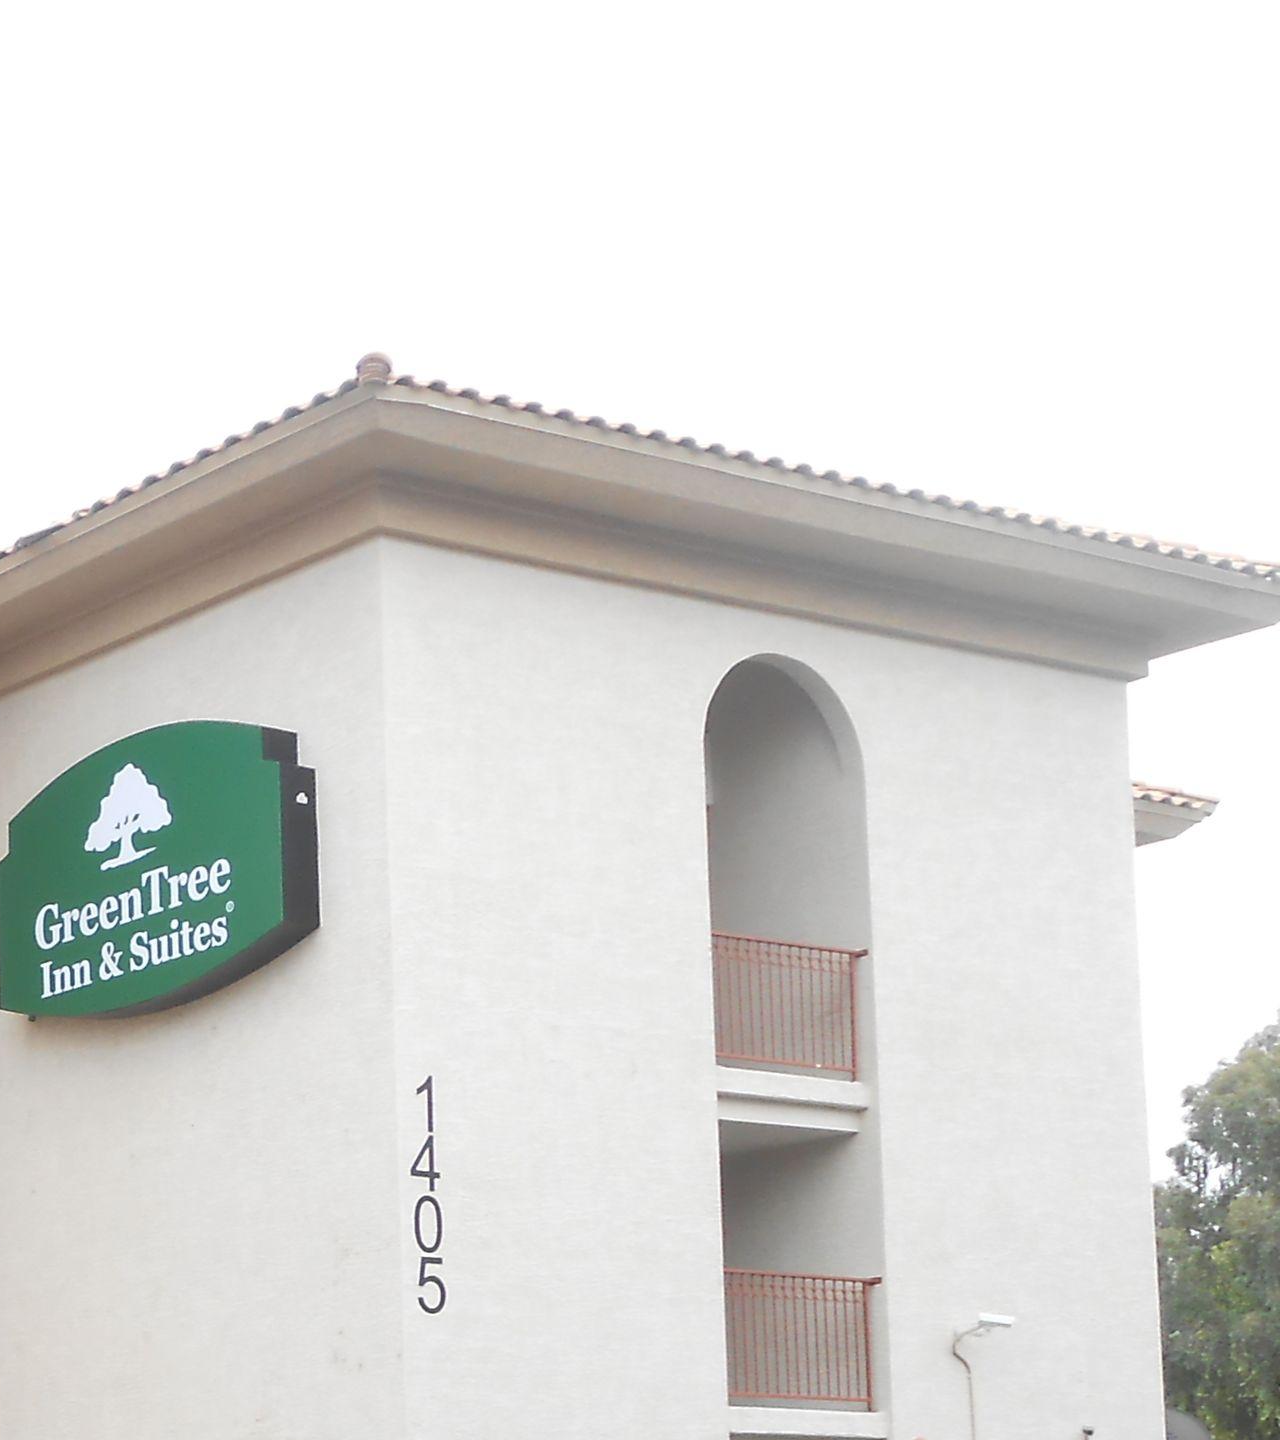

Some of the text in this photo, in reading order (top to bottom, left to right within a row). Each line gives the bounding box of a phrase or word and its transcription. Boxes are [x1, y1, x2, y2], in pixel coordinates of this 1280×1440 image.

[35, 858, 231, 950] GreenTree
[41, 916, 228, 998] Inn & Suites
[410, 1075, 446, 1314] 1405
